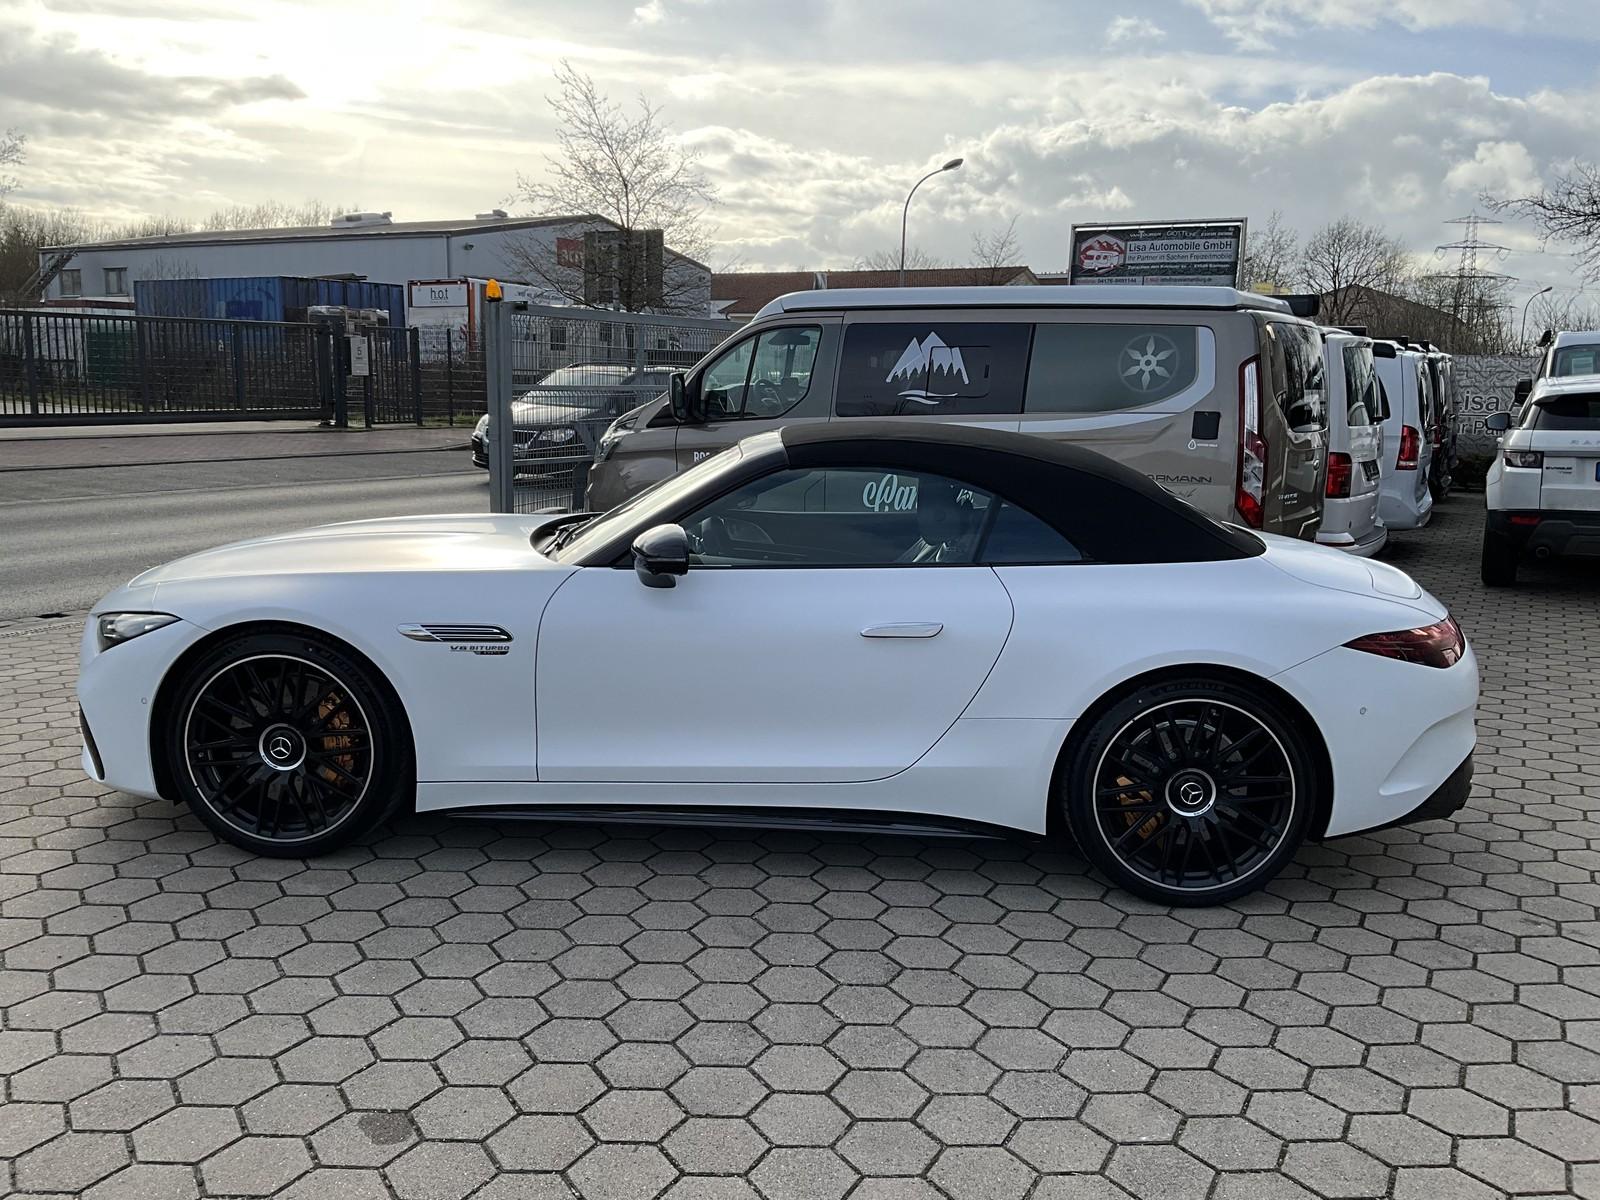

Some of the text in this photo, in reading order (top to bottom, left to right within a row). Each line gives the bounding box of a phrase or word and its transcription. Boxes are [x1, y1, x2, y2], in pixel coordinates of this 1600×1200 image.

[1128, 240, 1232, 252] Lisa Automobile GmbH
[1459, 390, 1500, 412] isa
